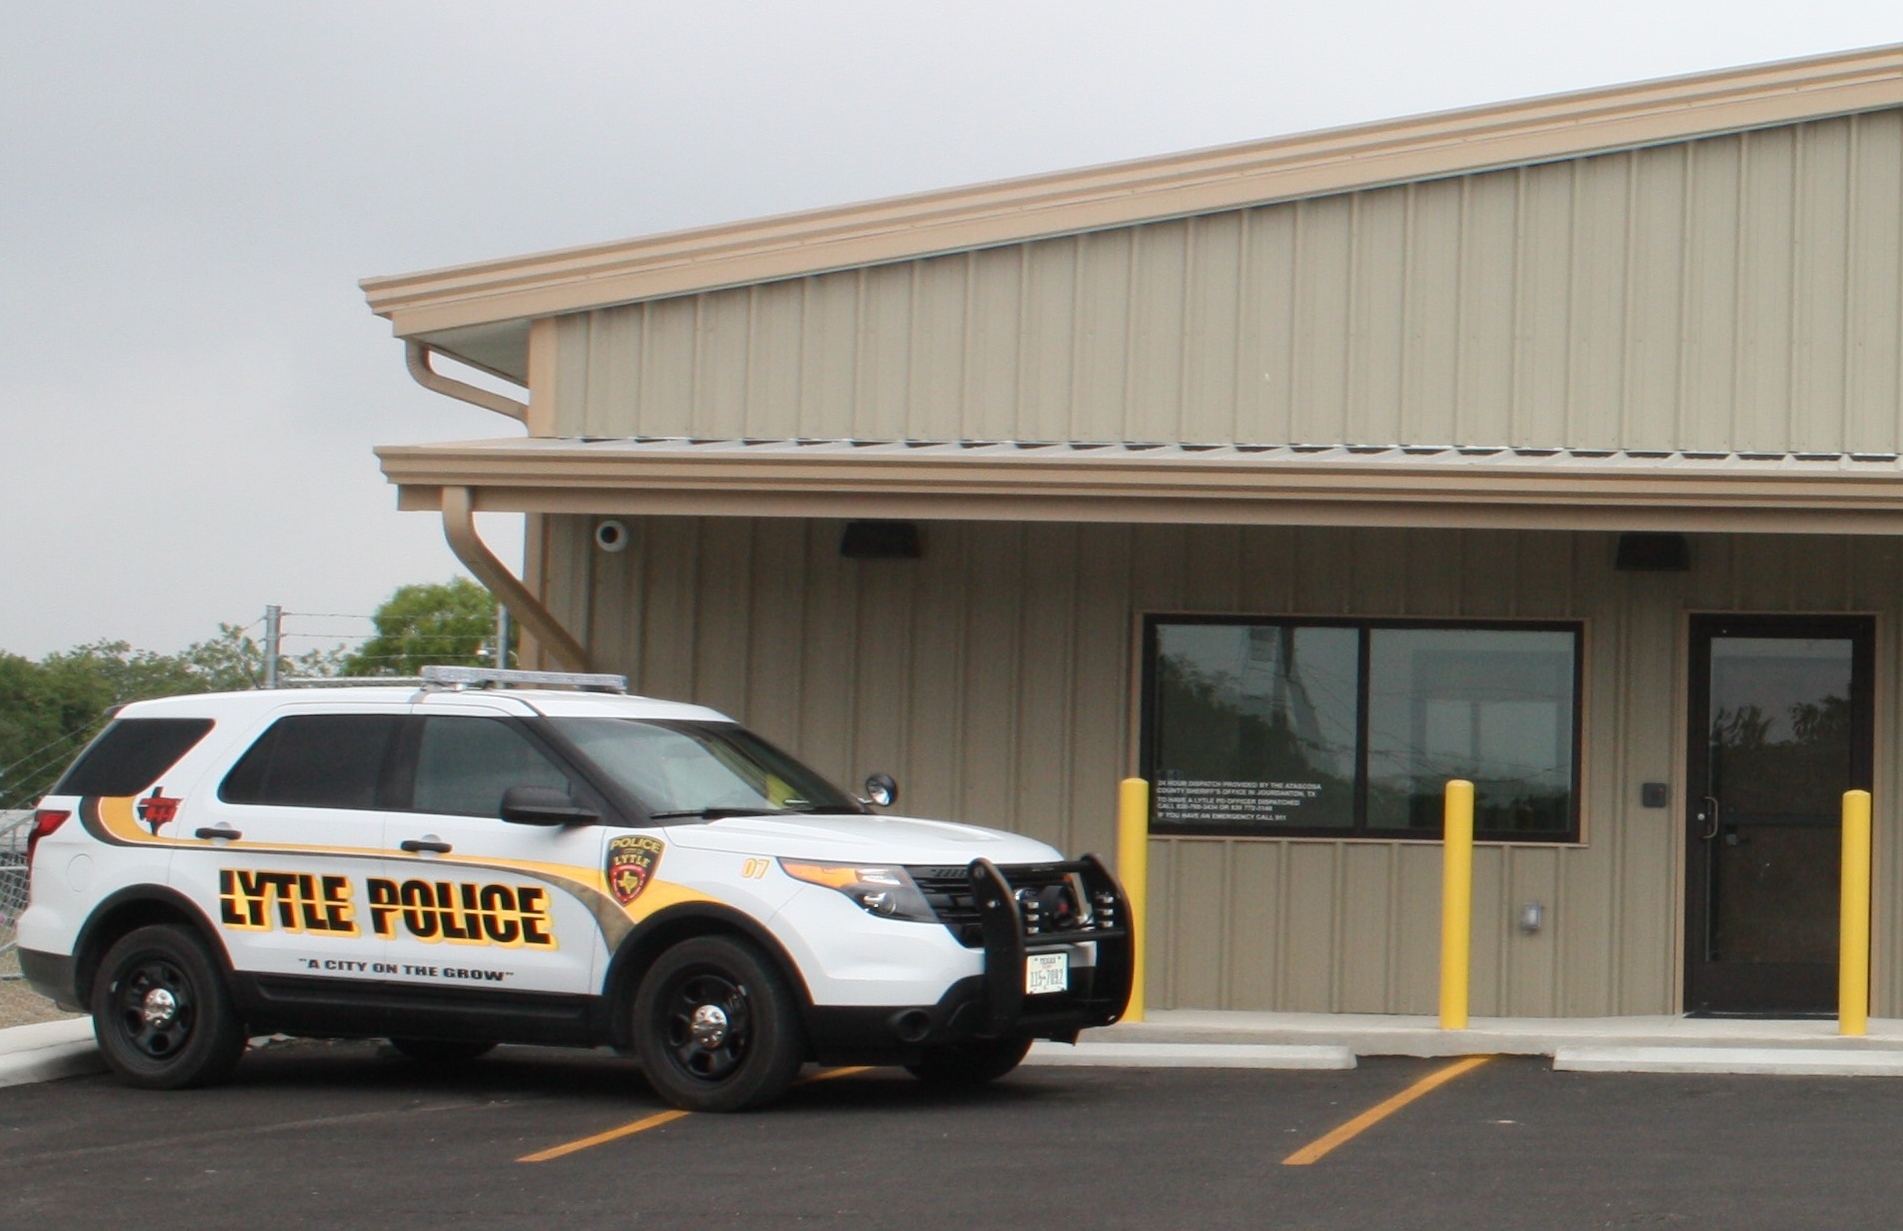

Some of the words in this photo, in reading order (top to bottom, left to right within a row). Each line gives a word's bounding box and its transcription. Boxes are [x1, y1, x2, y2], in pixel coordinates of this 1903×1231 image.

[610, 837, 661, 854] POLICE
[614, 855, 651, 868] LYTLE
[741, 858, 771, 880] 07
[219, 868, 361, 938] LYTLE
[367, 877, 560, 952] POLICE
[325, 960, 366, 974] CITY
[373, 962, 398, 976] ON
[403, 963, 439, 977] THE
